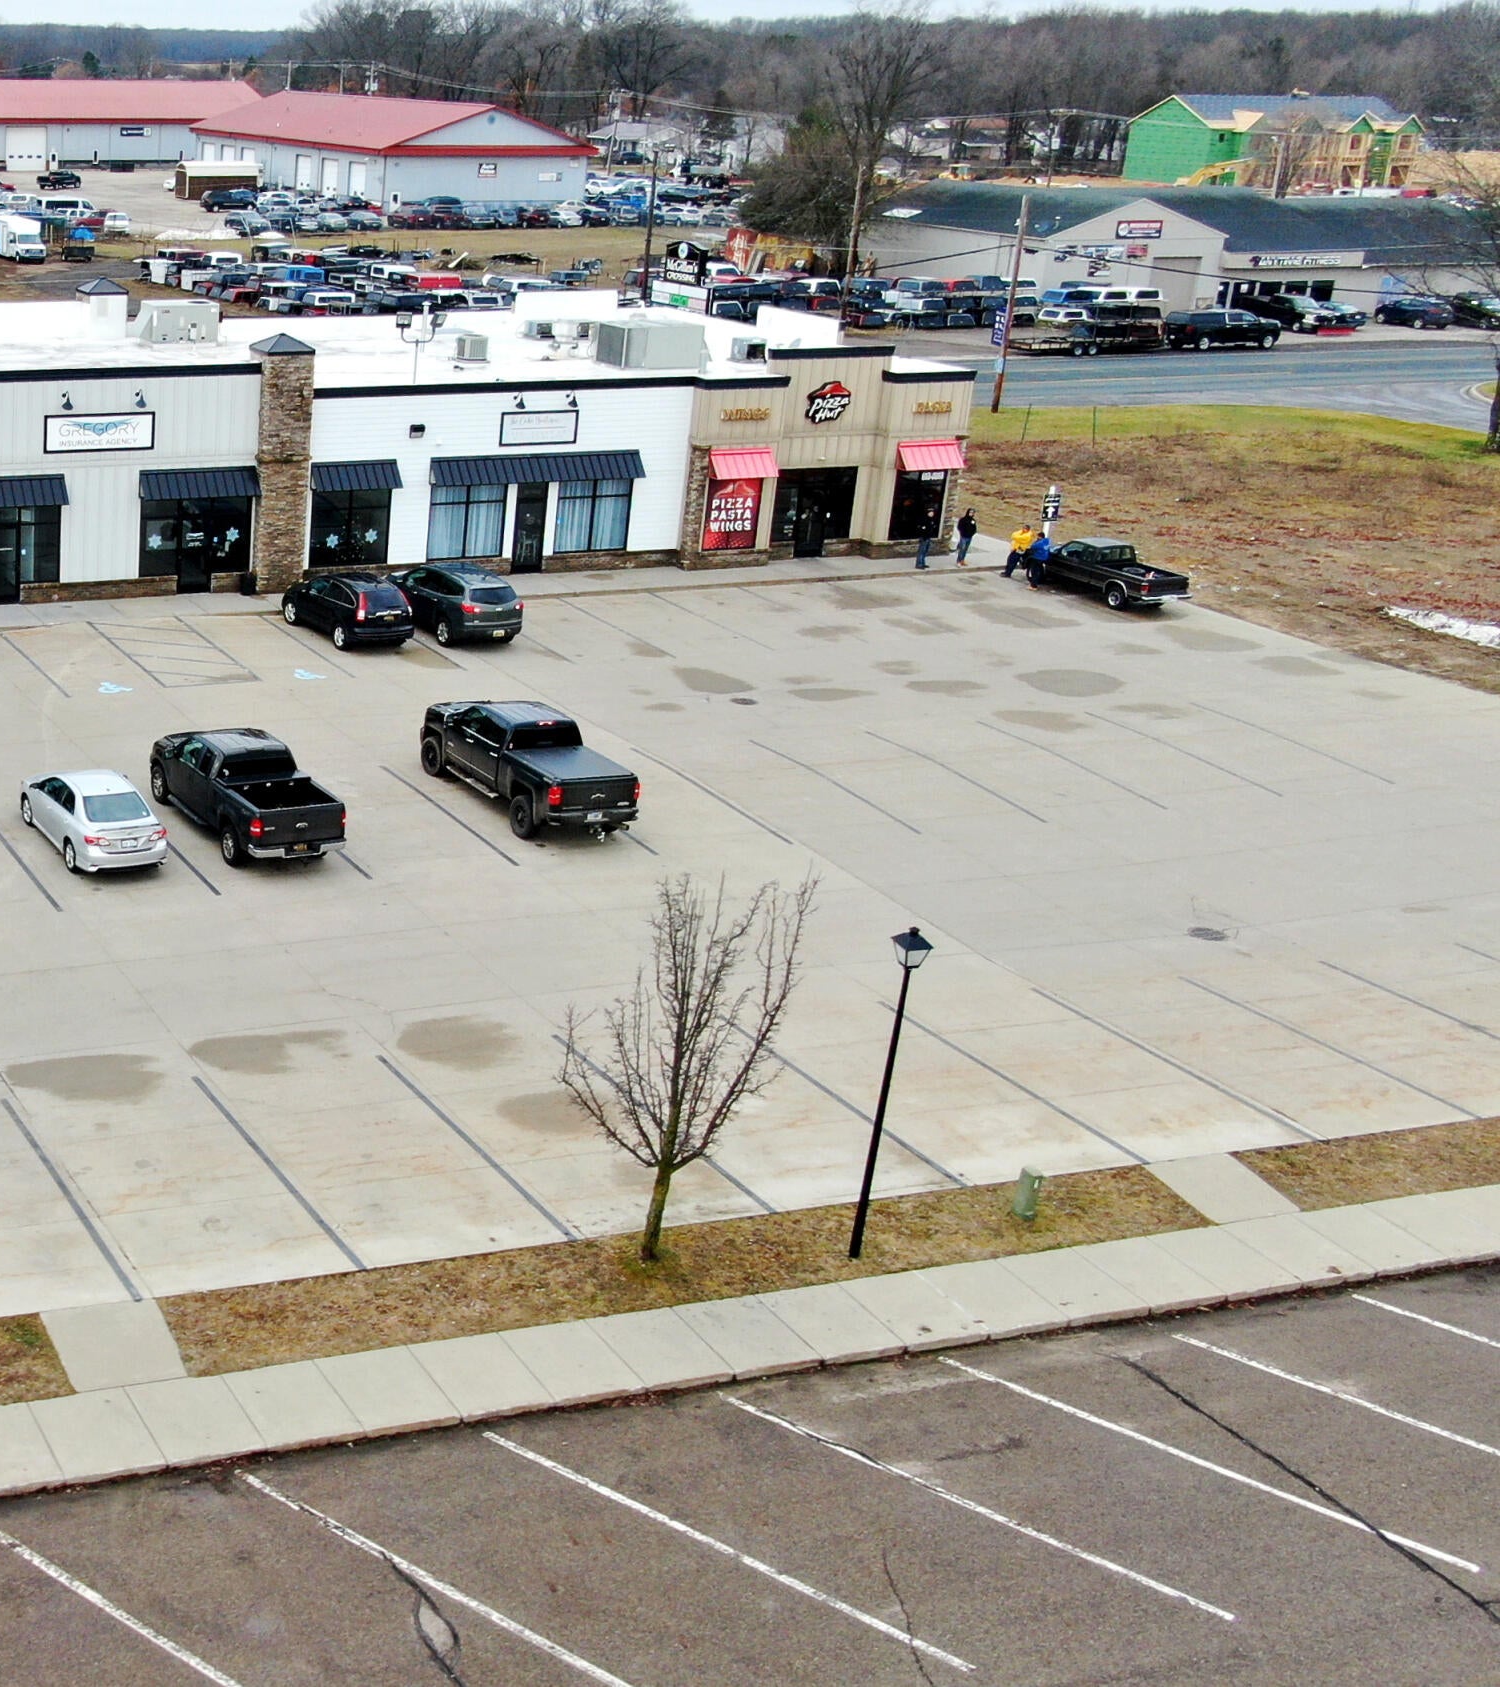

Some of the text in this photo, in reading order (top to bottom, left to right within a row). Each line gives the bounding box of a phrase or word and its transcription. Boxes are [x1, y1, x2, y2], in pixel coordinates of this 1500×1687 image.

[809, 394, 849, 417] Pizza
[815, 406, 844, 423] Hut
[59, 422, 140, 437] GREGORY
[59, 438, 137, 447] INSURANCE AGENCY
[711, 497, 753, 509] PIZZA
[710, 508, 751, 520] PASTA
[710, 520, 751, 532] WINGS
